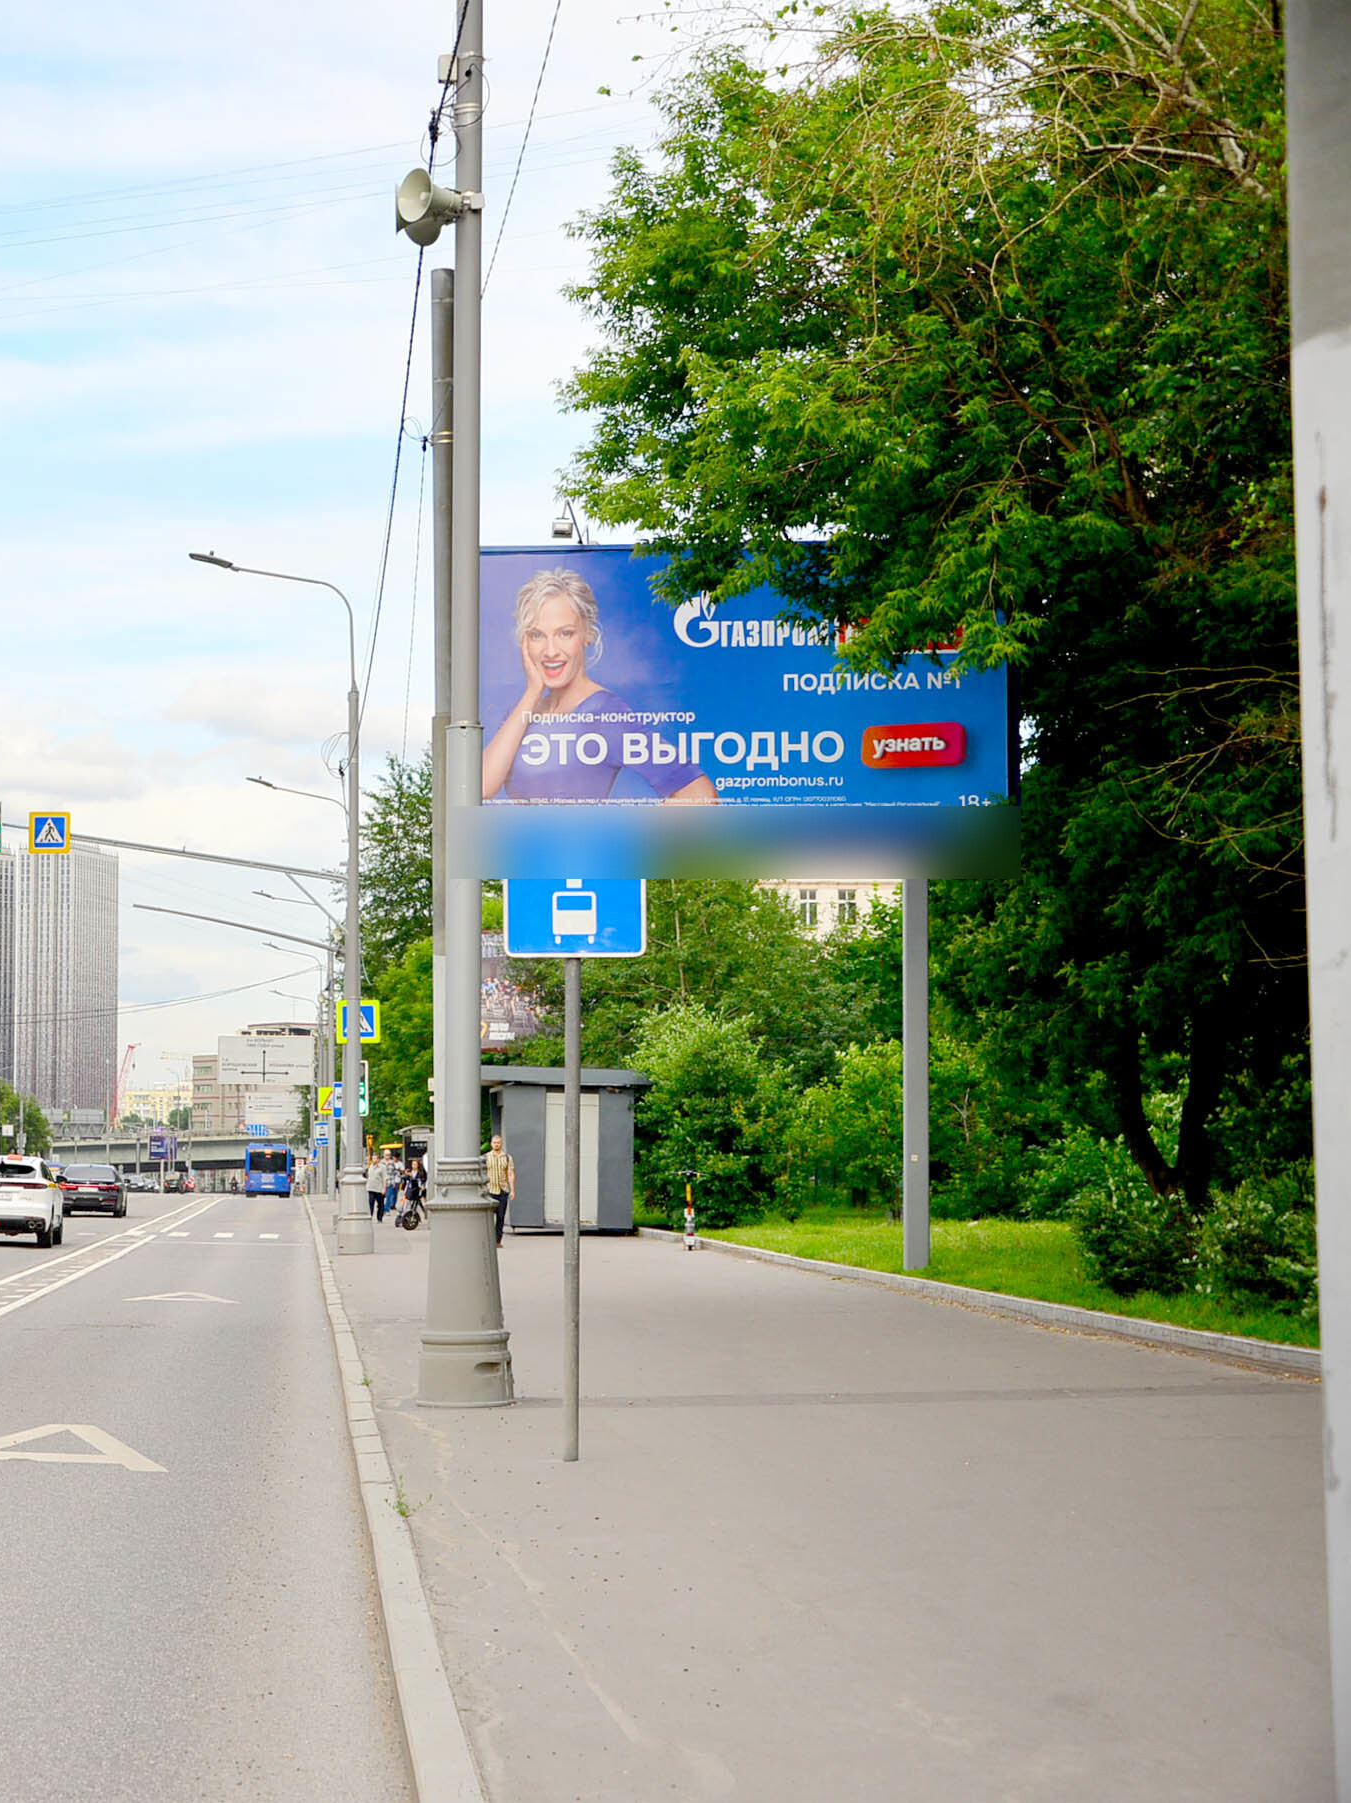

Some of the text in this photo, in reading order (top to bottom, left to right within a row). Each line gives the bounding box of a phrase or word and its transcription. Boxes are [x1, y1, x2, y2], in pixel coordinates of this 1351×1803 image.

[782, 672, 921, 695] ПОДПИСКА
[521, 711, 696, 725] Подписка-конструктор
[521, 731, 846, 771] ЭТО ВЫГОДНО
[872, 737, 947, 759] узнать
[715, 775, 844, 790] gazprombonus.ru
[958, 794, 992, 807] 18+
